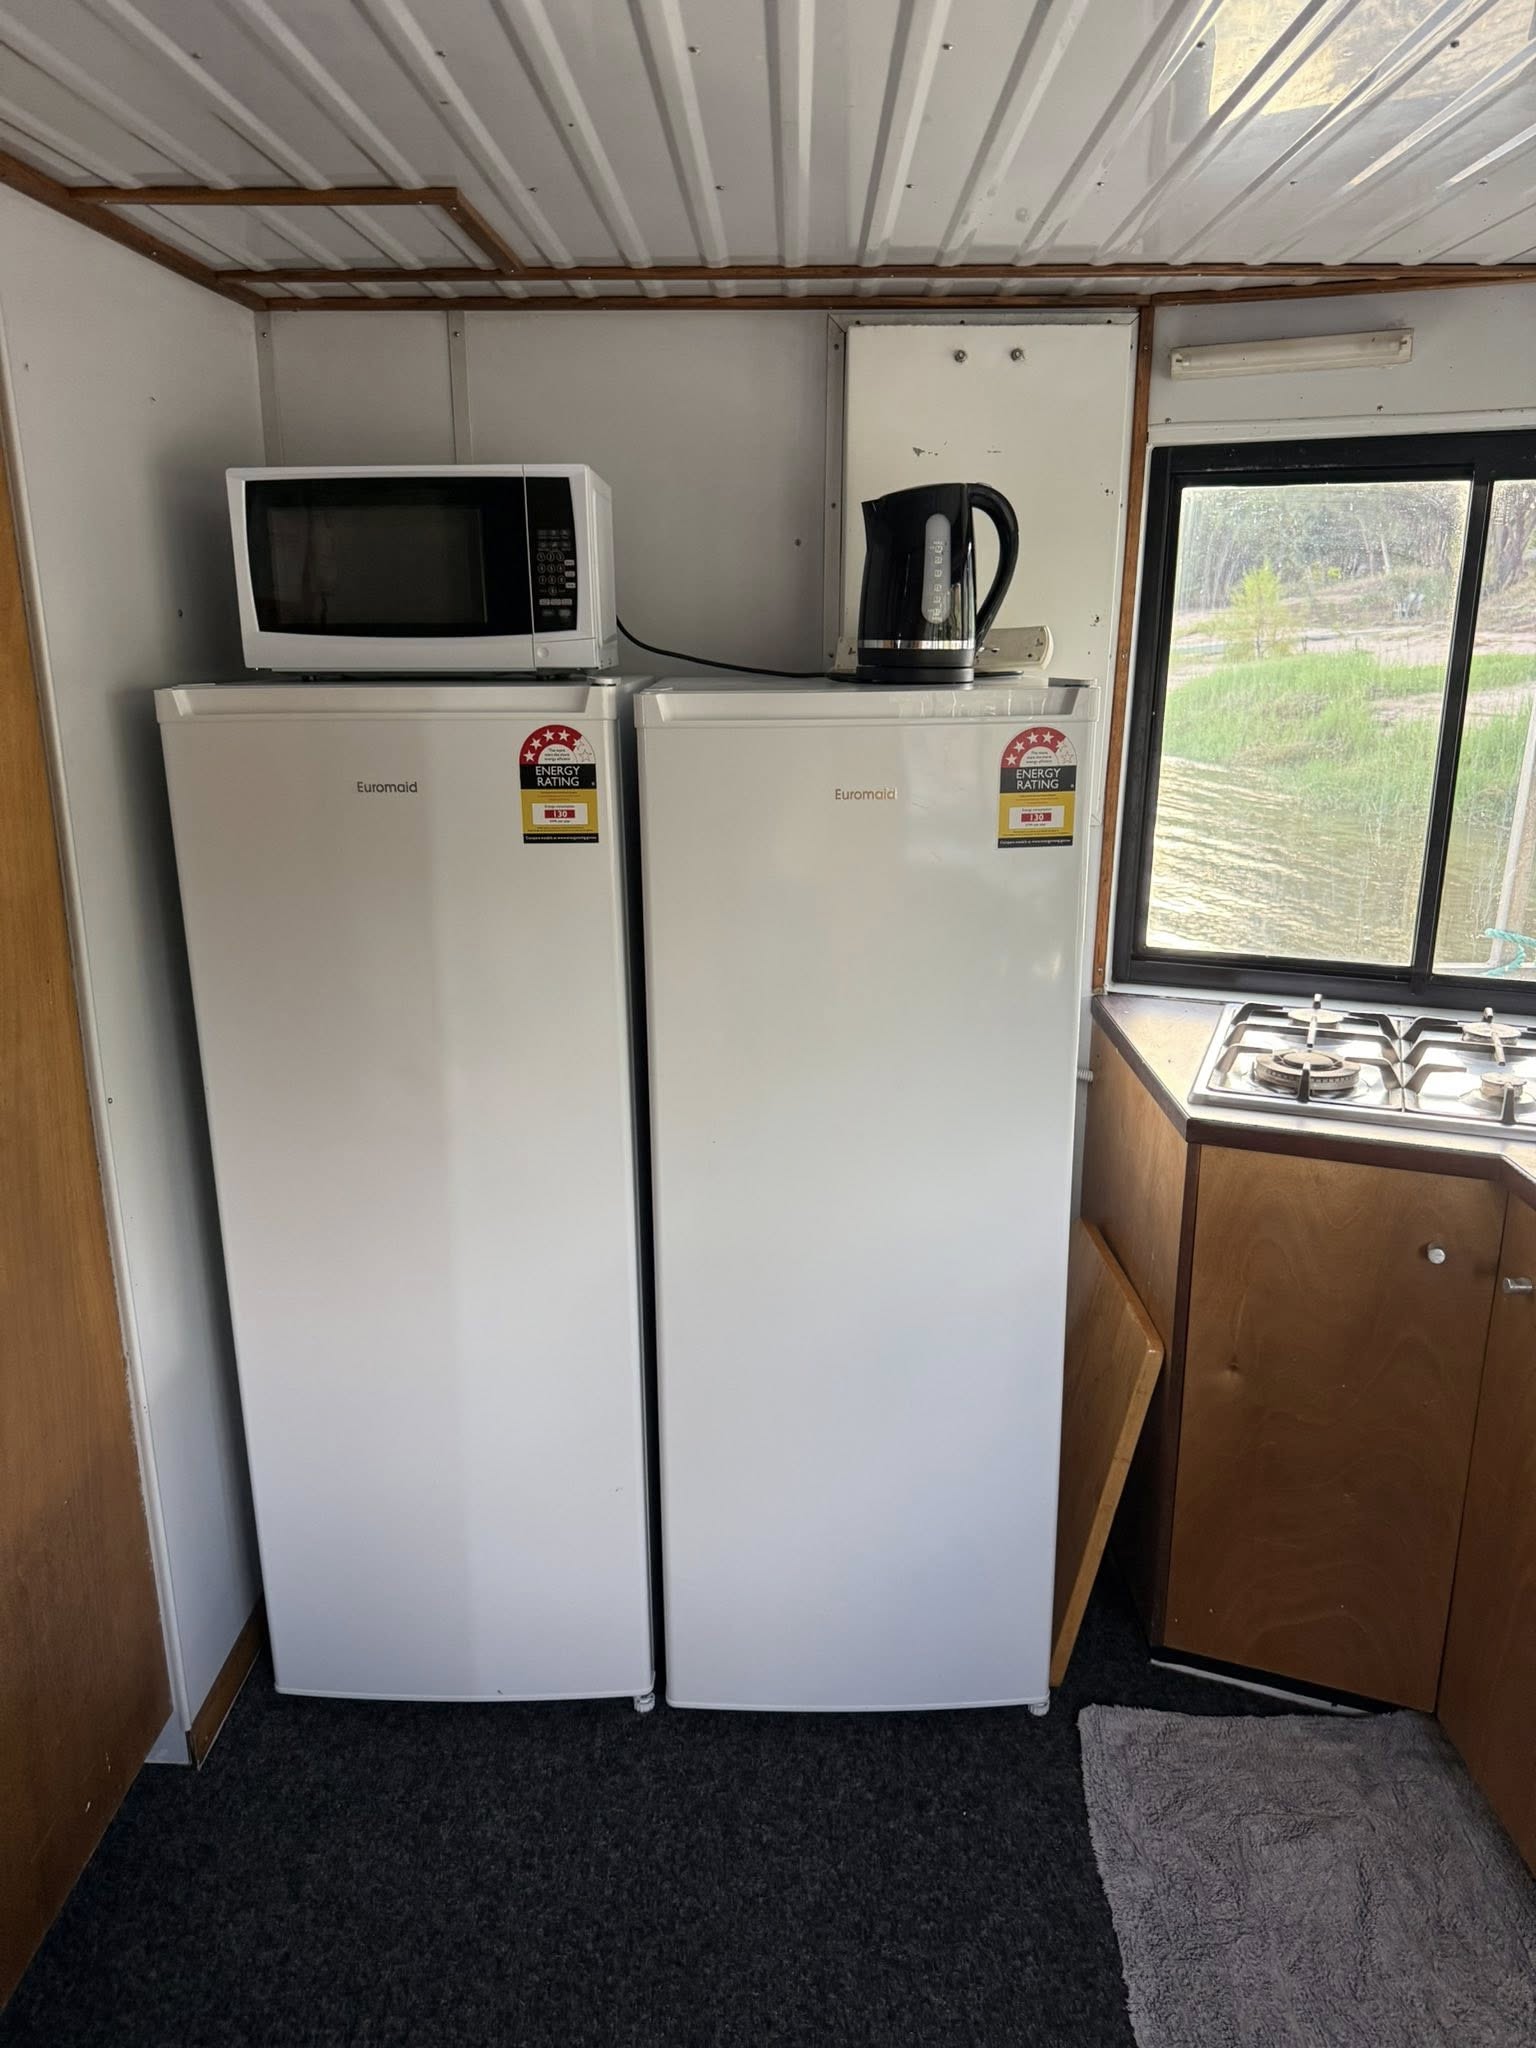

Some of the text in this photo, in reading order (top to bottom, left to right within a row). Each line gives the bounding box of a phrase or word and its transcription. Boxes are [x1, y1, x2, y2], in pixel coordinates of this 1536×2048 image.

[535, 766, 580, 776] ENERGY
[1016, 768, 1061, 780] ENERGY
[356, 781, 418, 793] Euromaid
[537, 777, 580, 787] RATING
[1016, 779, 1059, 790] RATING
[835, 788, 896, 801] Euromaid
[553, 810, 568, 818] 130
